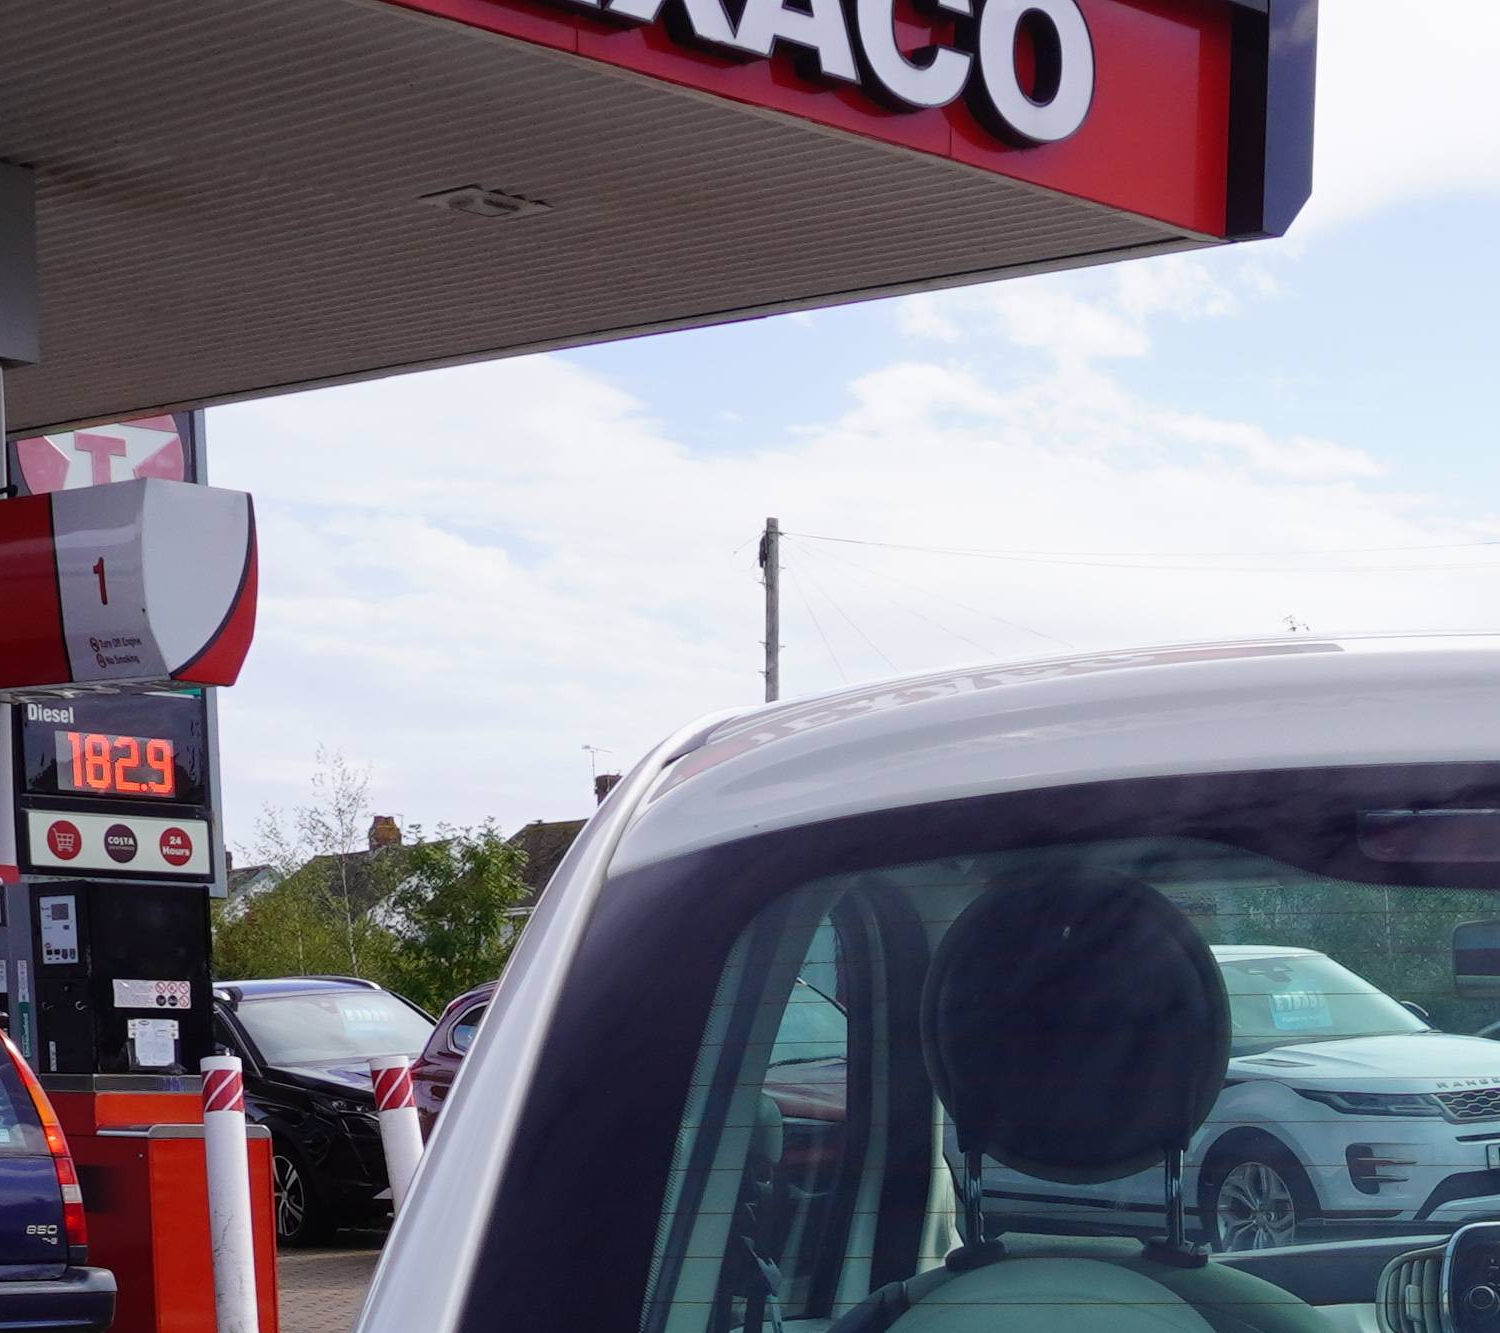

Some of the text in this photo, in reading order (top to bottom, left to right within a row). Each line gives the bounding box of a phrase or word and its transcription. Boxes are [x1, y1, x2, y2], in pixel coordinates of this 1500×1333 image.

[92, 556, 108, 605] 1
[27, 703, 74, 723] Diesel
[67, 731, 176, 794] 182.9
[107, 836, 135, 846] COSTA
[169, 836, 182, 845] 24
[162, 846, 190, 857] Hours
[1435, 1077, 1500, 1089] RANGE
[26, 1224, 58, 1234] 850
